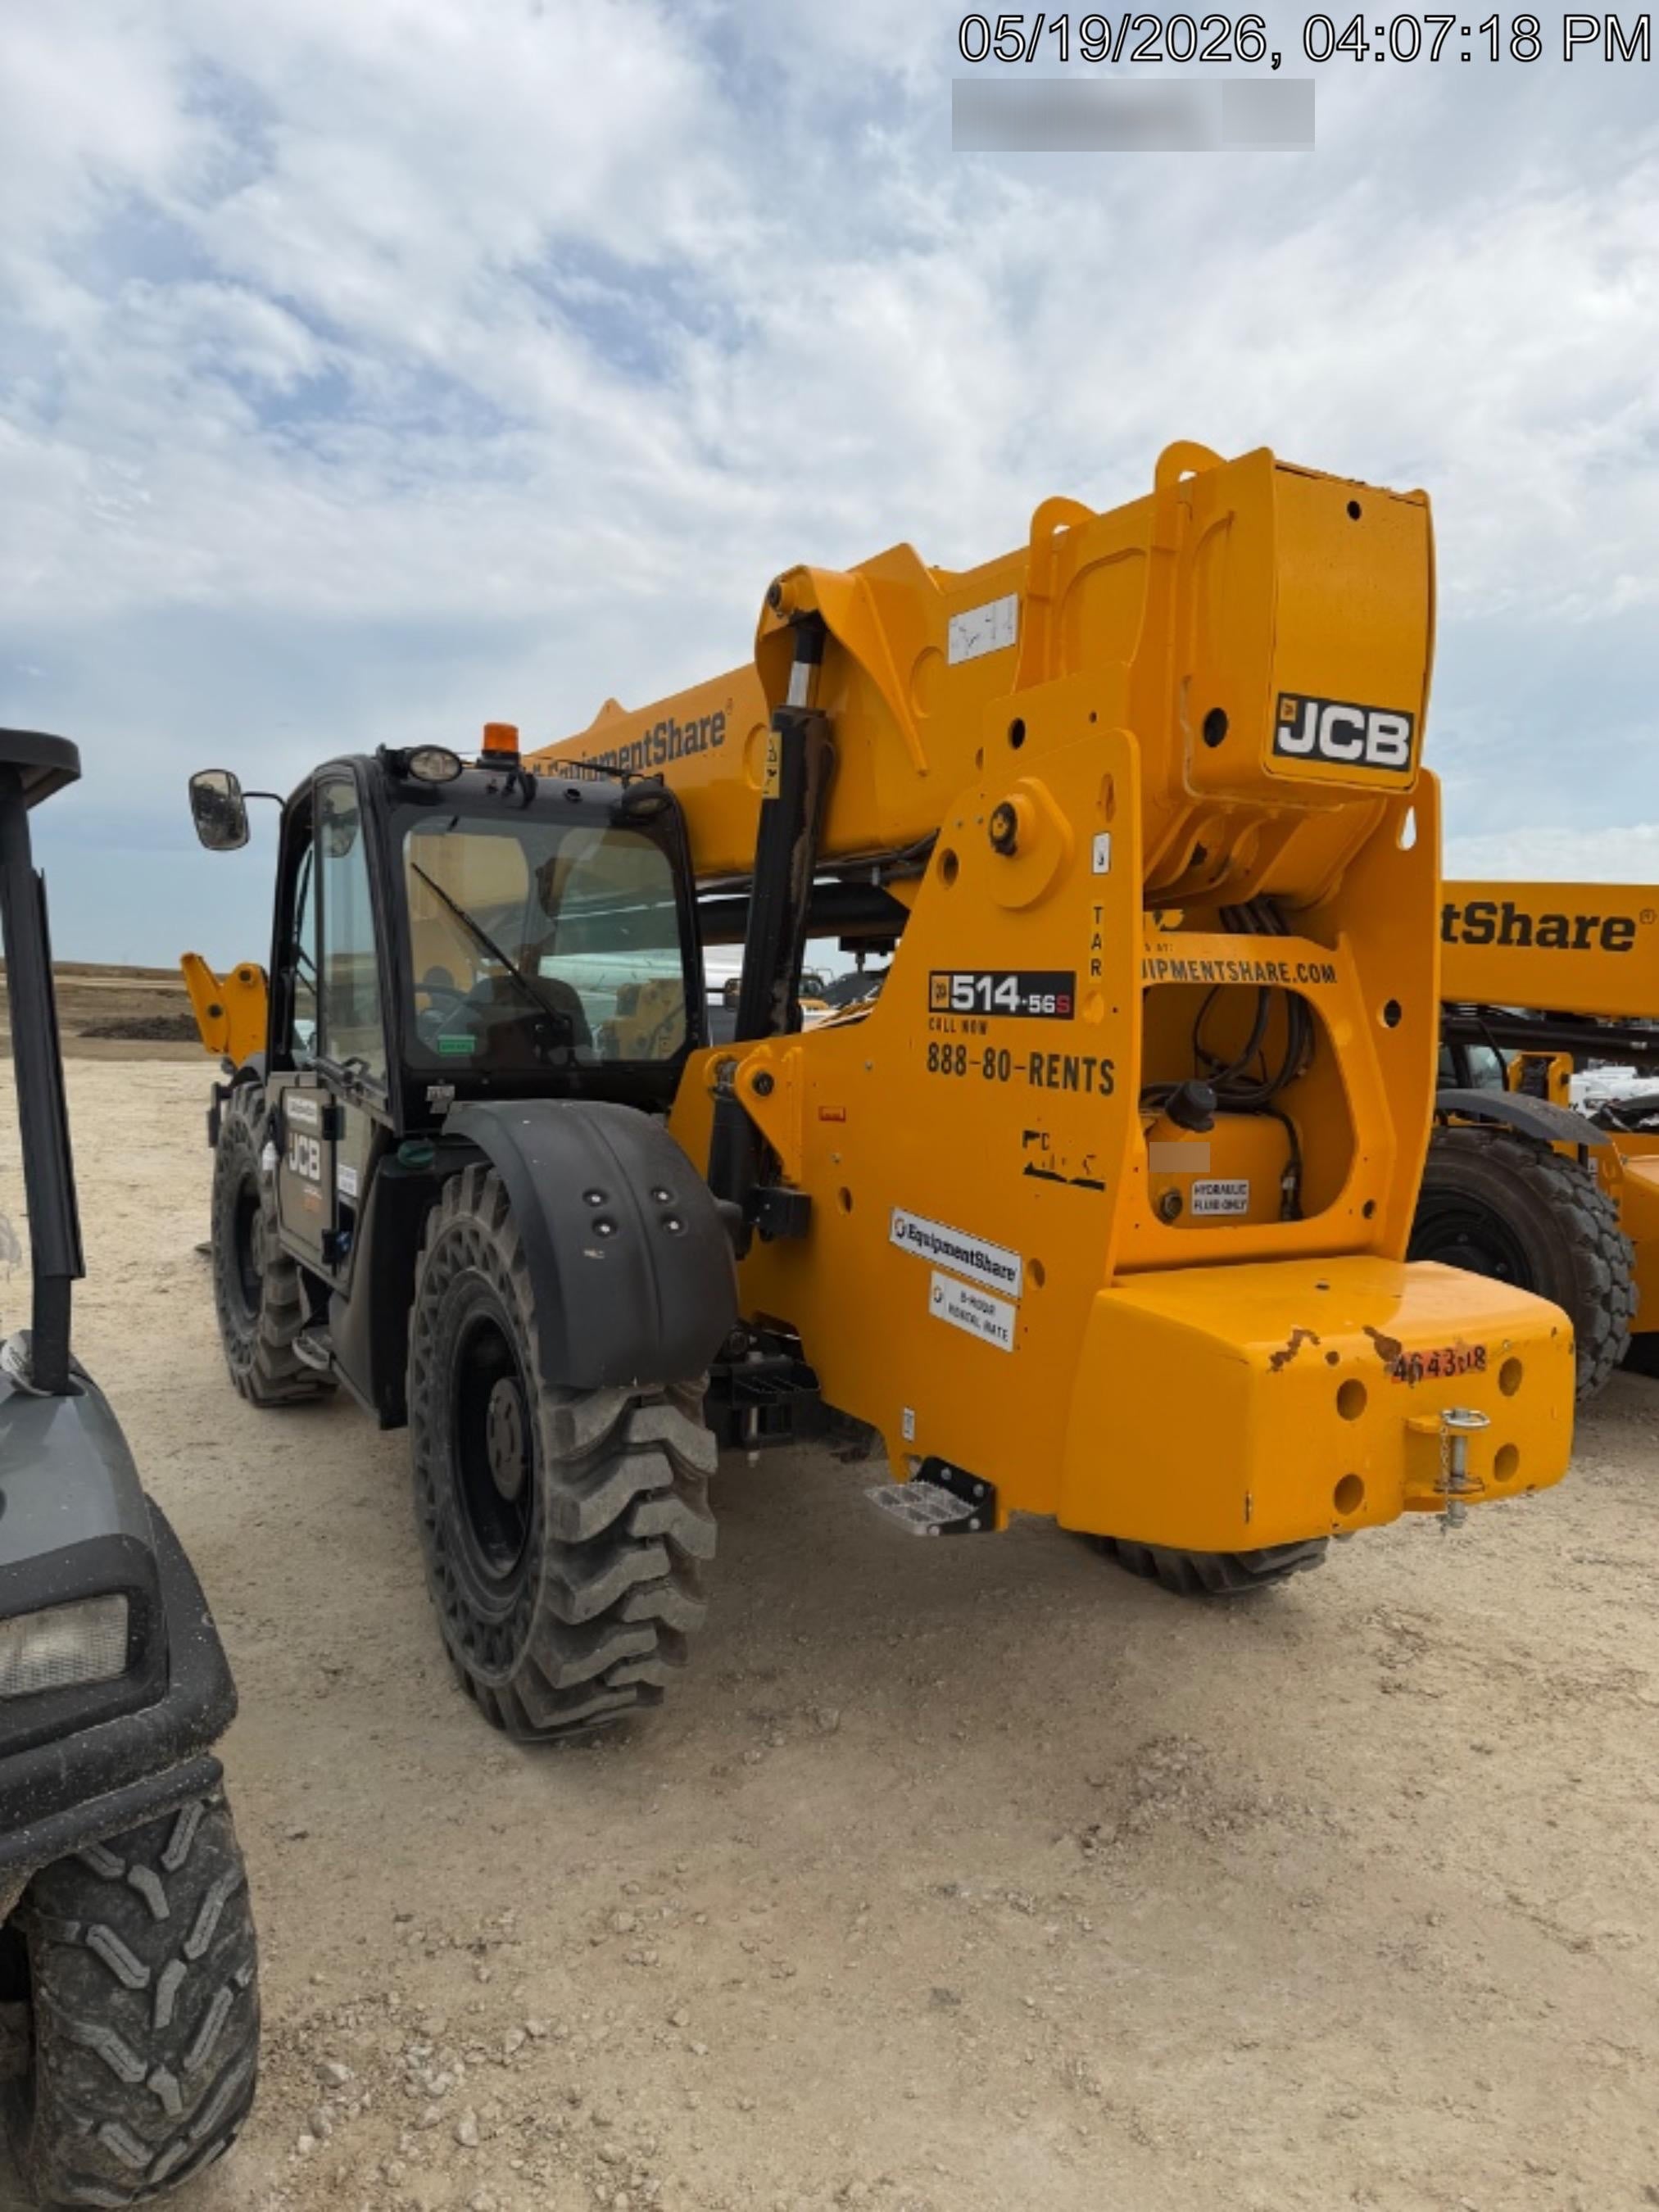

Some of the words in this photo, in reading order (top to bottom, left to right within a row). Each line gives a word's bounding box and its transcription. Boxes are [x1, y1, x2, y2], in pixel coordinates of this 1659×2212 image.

[1277, 701, 1411, 767] JCB
[928, 1017, 957, 1034] CALL
[961, 1019, 988, 1036] NOW
[927, 1041, 1115, 1096] 888-80-RENTS
[289, 1131, 320, 1181] JCB
[907, 1223, 1018, 1282] EquipmentShare
